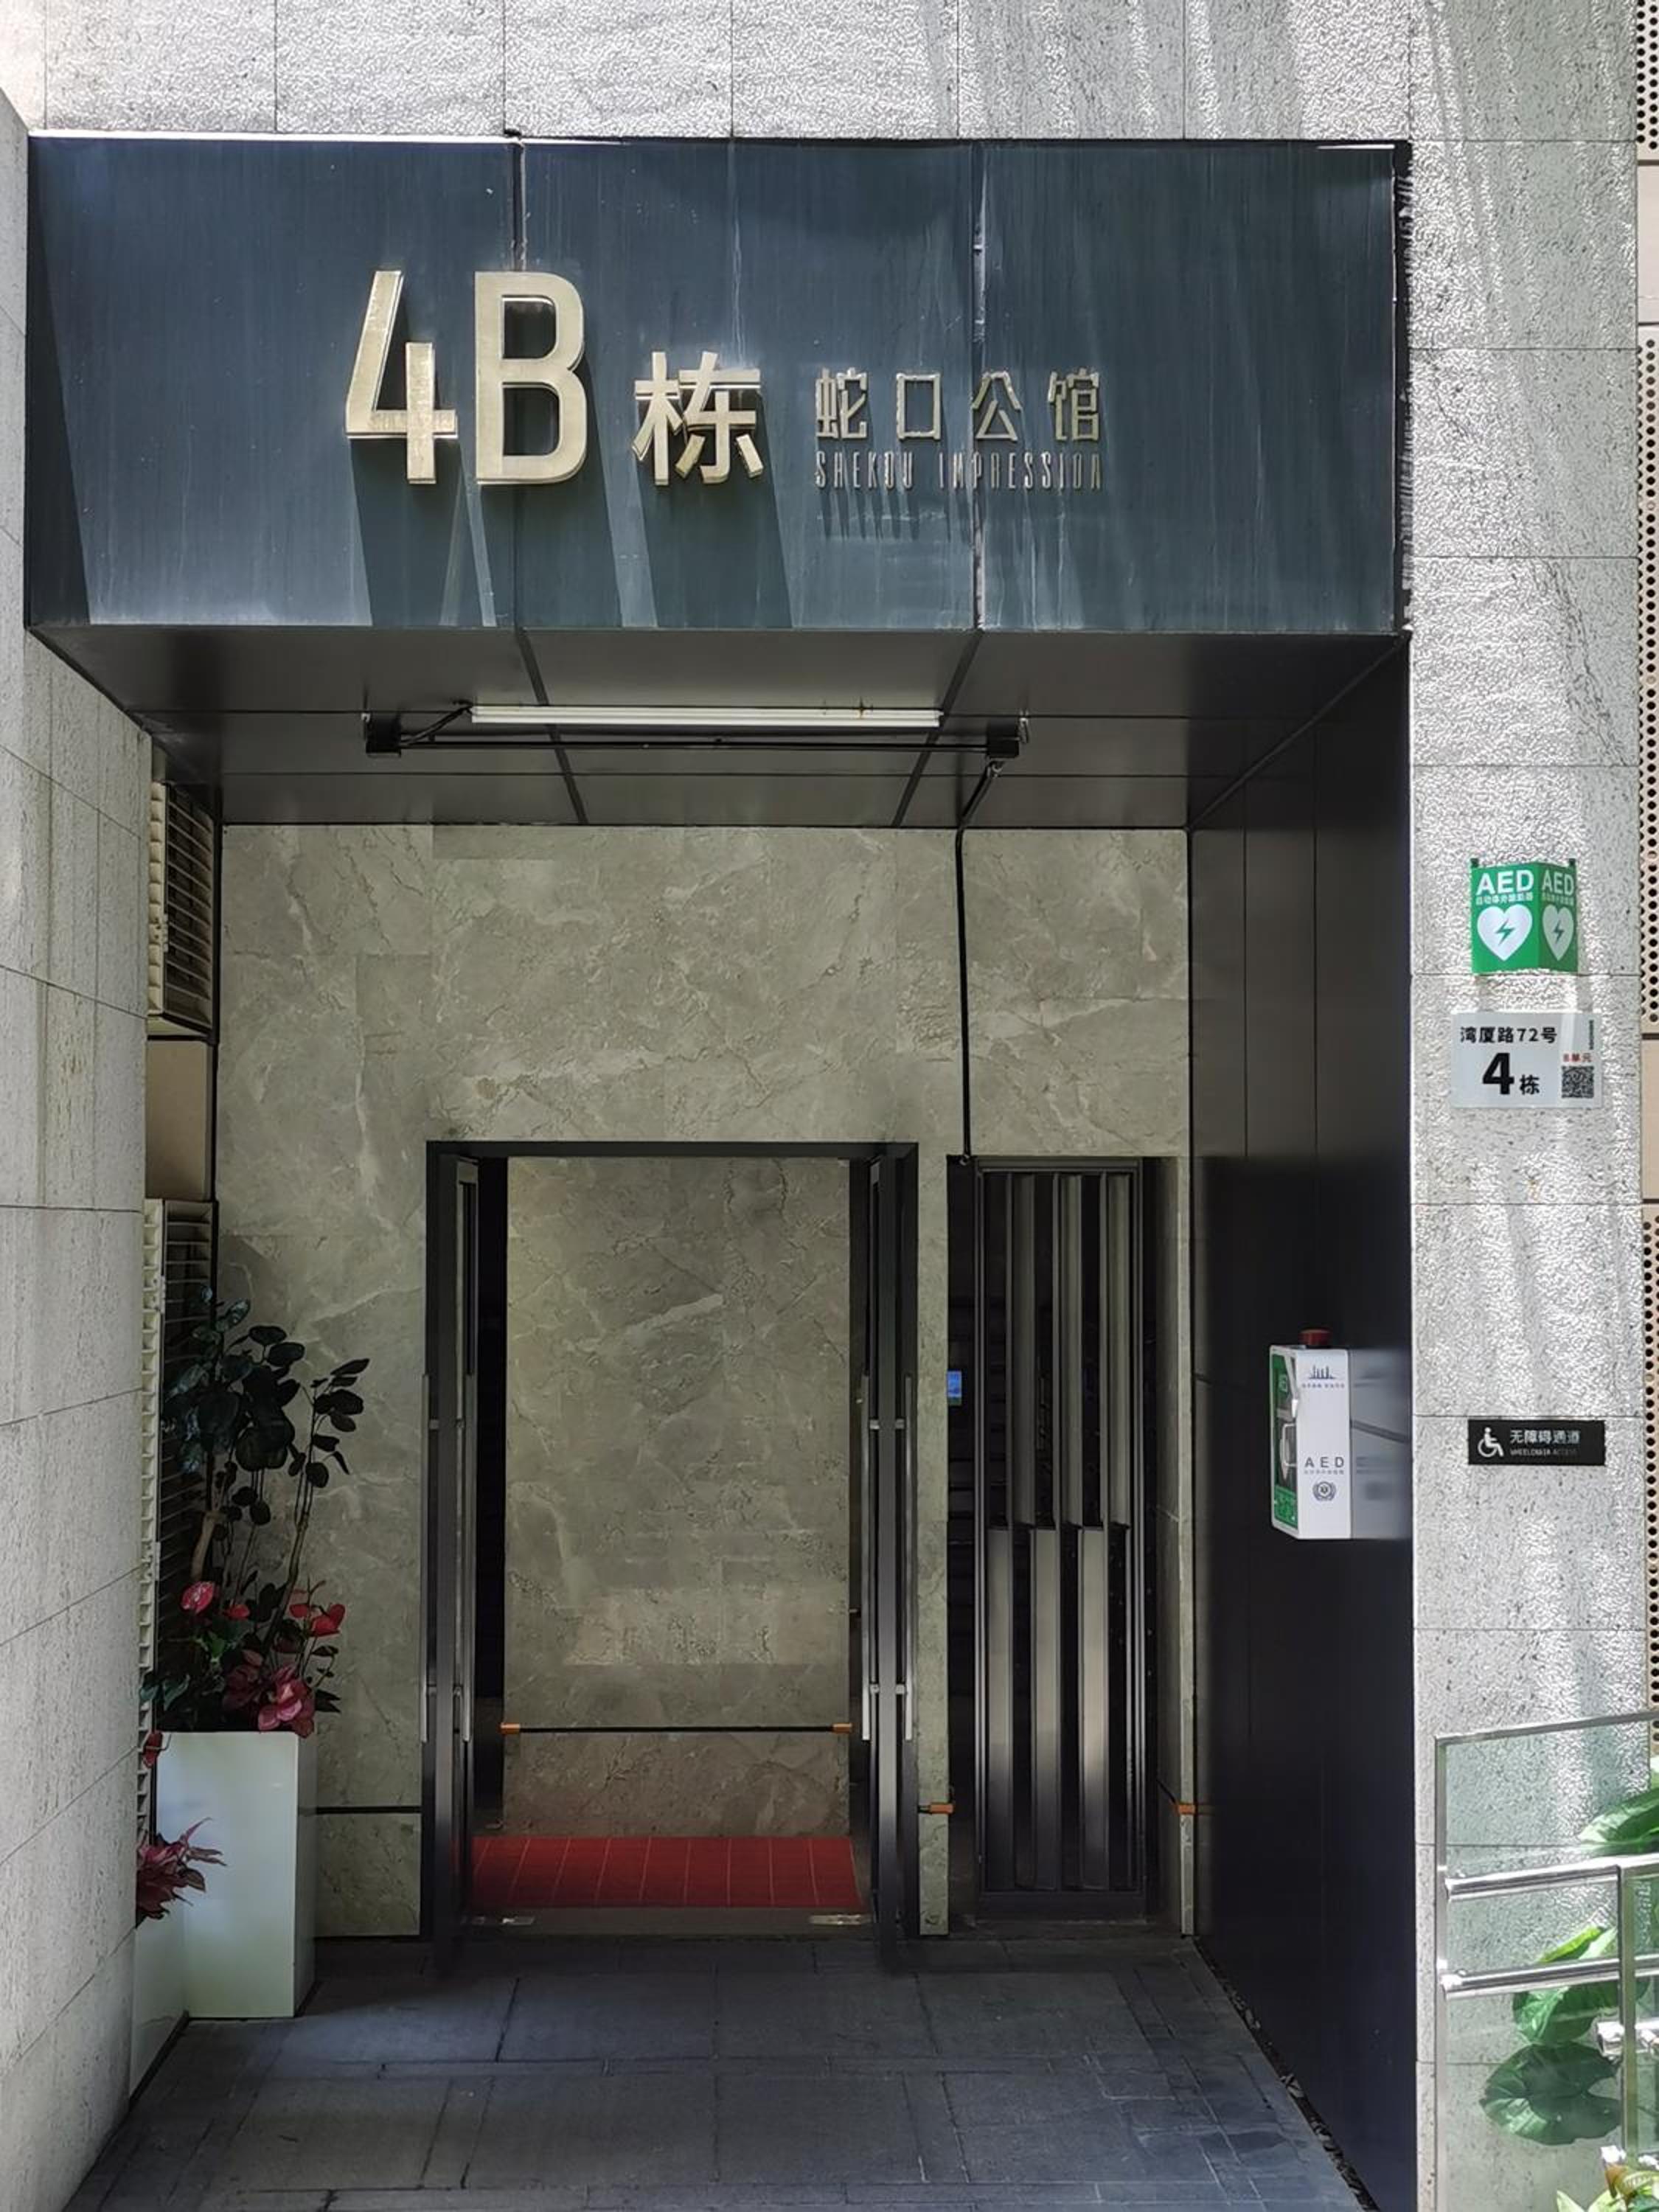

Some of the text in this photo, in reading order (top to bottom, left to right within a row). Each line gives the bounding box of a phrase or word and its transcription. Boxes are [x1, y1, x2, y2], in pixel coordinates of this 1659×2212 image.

[815, 367, 1100, 441] 蛇口公馆
[815, 451, 1101, 490] SHEKOU IMPRESSION
[1476, 869, 1534, 895] AED
[1541, 869, 1575, 895] AED
[1460, 1026, 1558, 1043] 湾厦路72号
[1481, 1052, 1540, 1096] 4栋
[1509, 1429, 1581, 1444] 无障碍通道
[1304, 1456, 1344, 1468] AED
